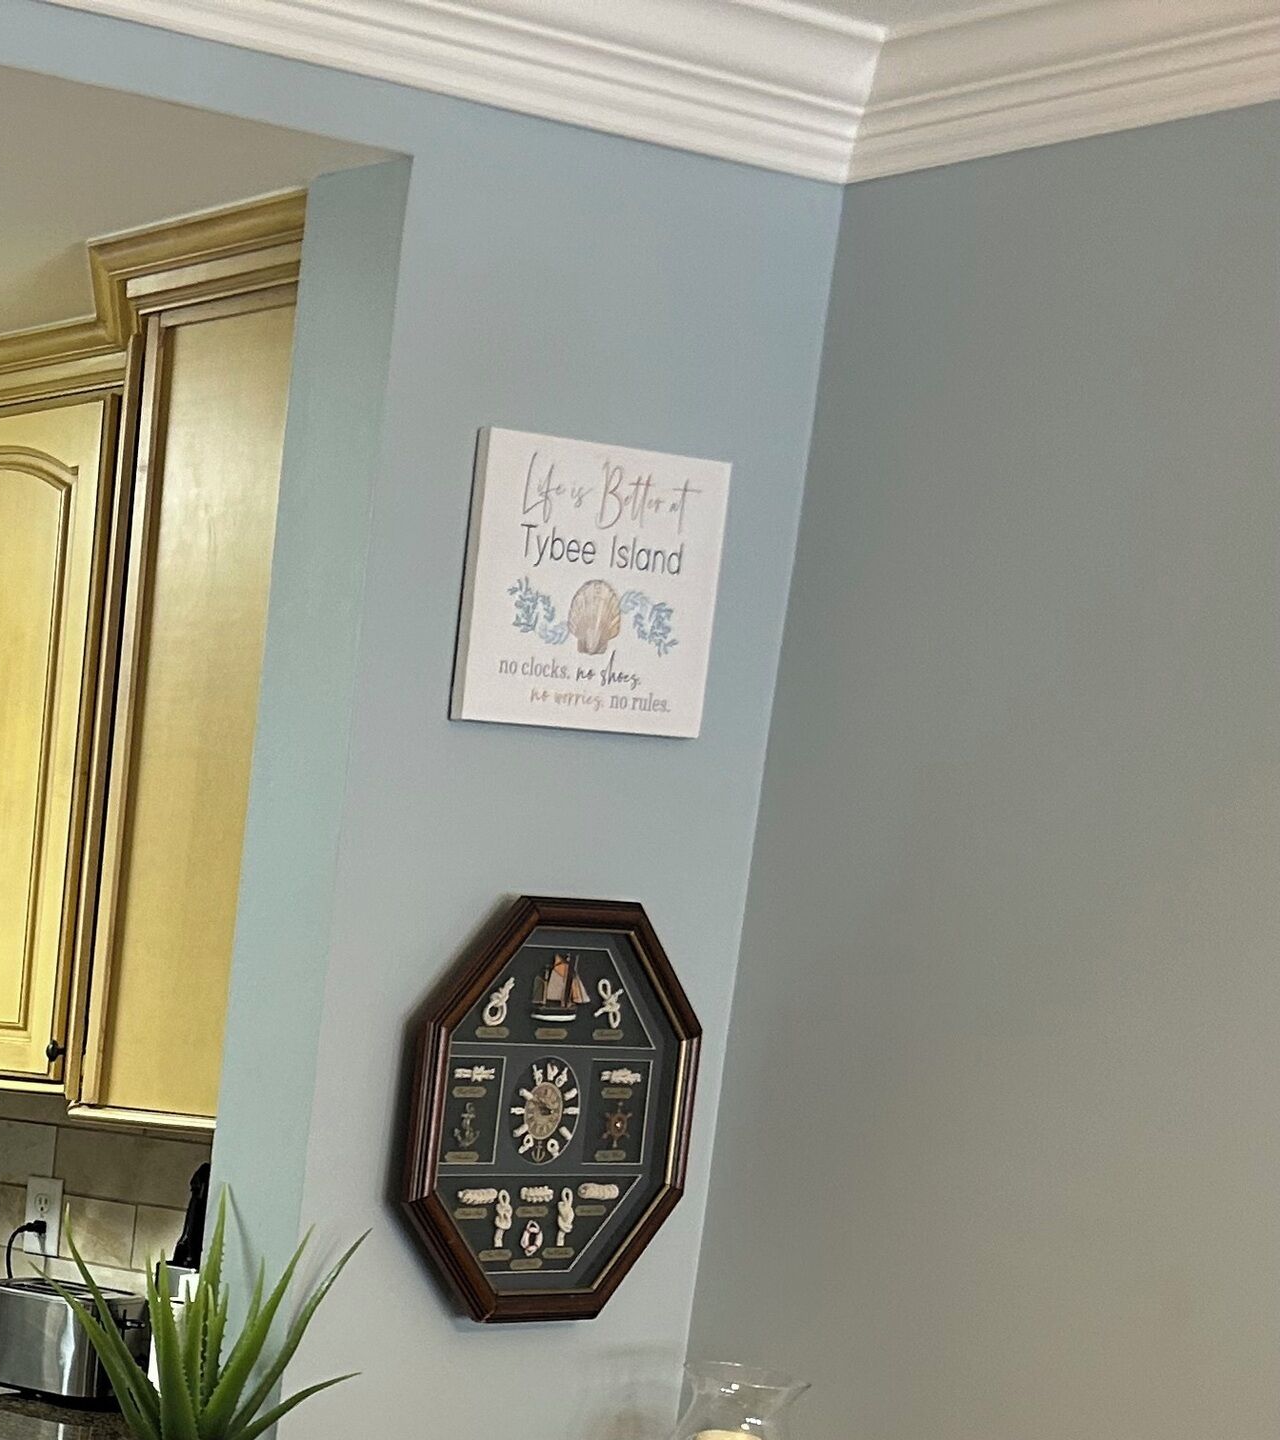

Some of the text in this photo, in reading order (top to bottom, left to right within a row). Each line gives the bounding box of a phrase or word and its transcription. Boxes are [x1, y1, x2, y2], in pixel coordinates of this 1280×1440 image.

[522, 451, 566, 524] Life
[571, 482, 592, 508] is
[595, 461, 663, 530] Better
[520, 523, 684, 576] Tybee Island
[498, 659, 518, 675] no
[521, 656, 571, 680] clocks.
[575, 666, 596, 682] no
[530, 687, 550, 703] no
[609, 693, 628, 711] no
[631, 692, 672, 713] rules.
